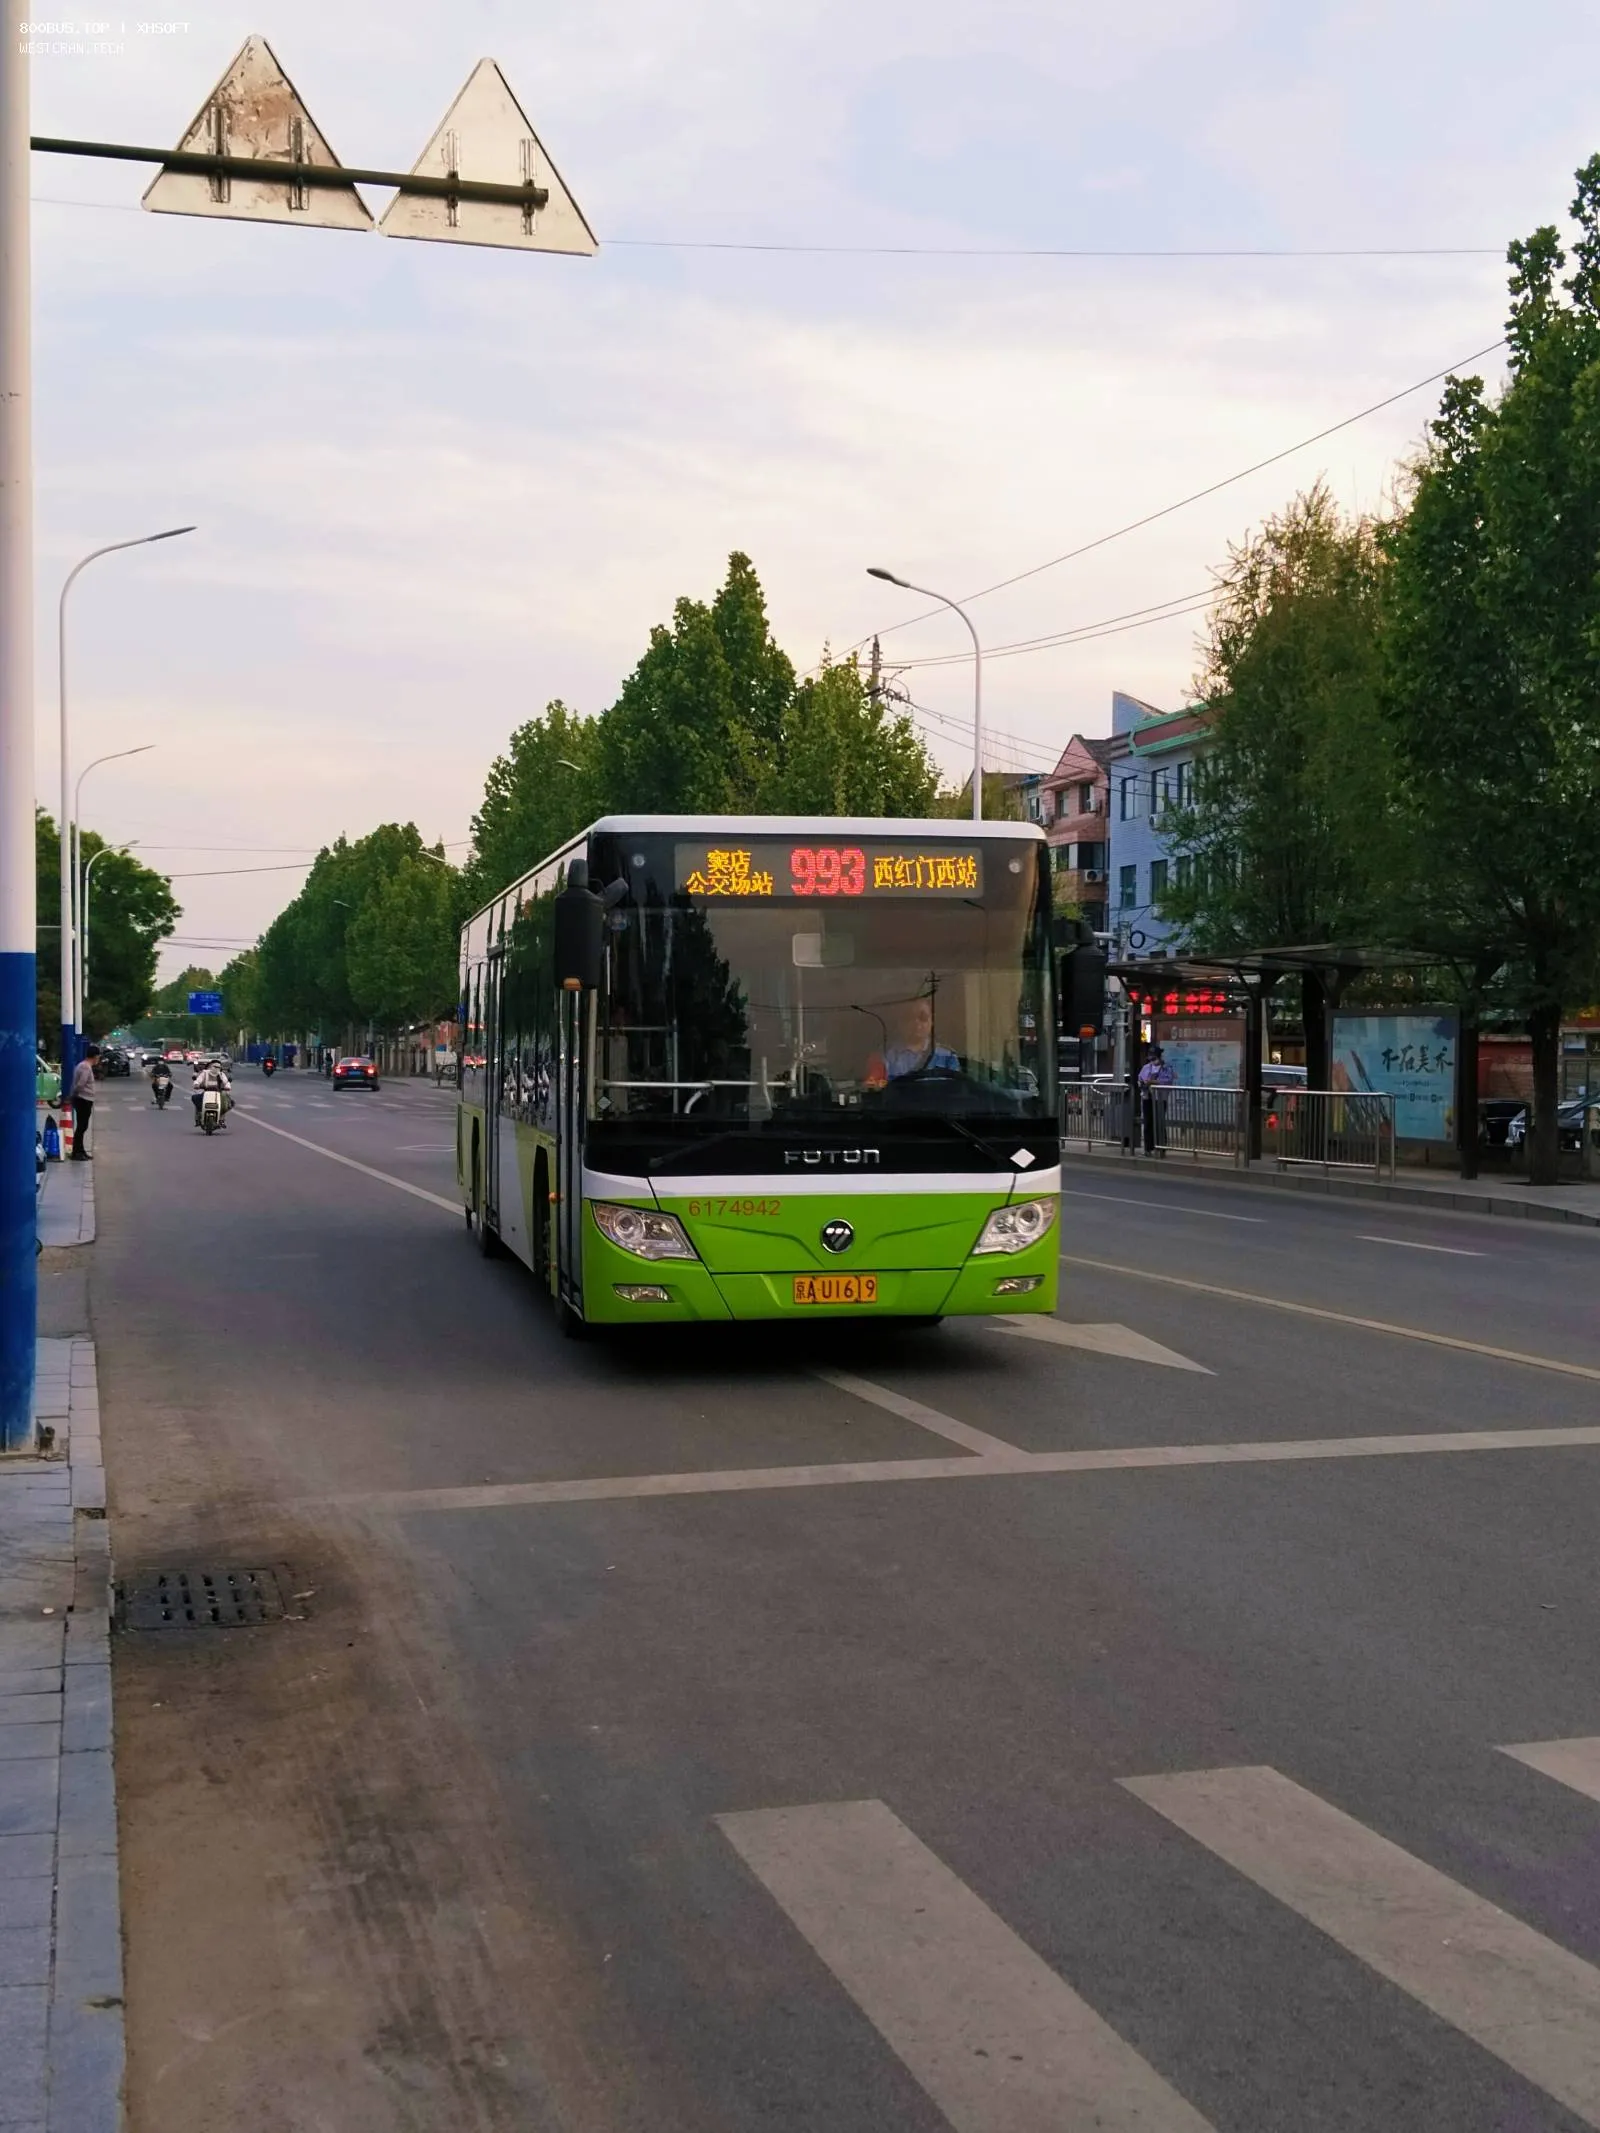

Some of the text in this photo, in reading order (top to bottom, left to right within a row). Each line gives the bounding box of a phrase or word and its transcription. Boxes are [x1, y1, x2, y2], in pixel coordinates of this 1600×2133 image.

[686, 871, 774, 896] 公交场站
[791, 848, 867, 895] 993
[873, 855, 978, 889] 西红门西站
[784, 1149, 880, 1164] FOTON
[688, 1199, 781, 1217] 6174942
